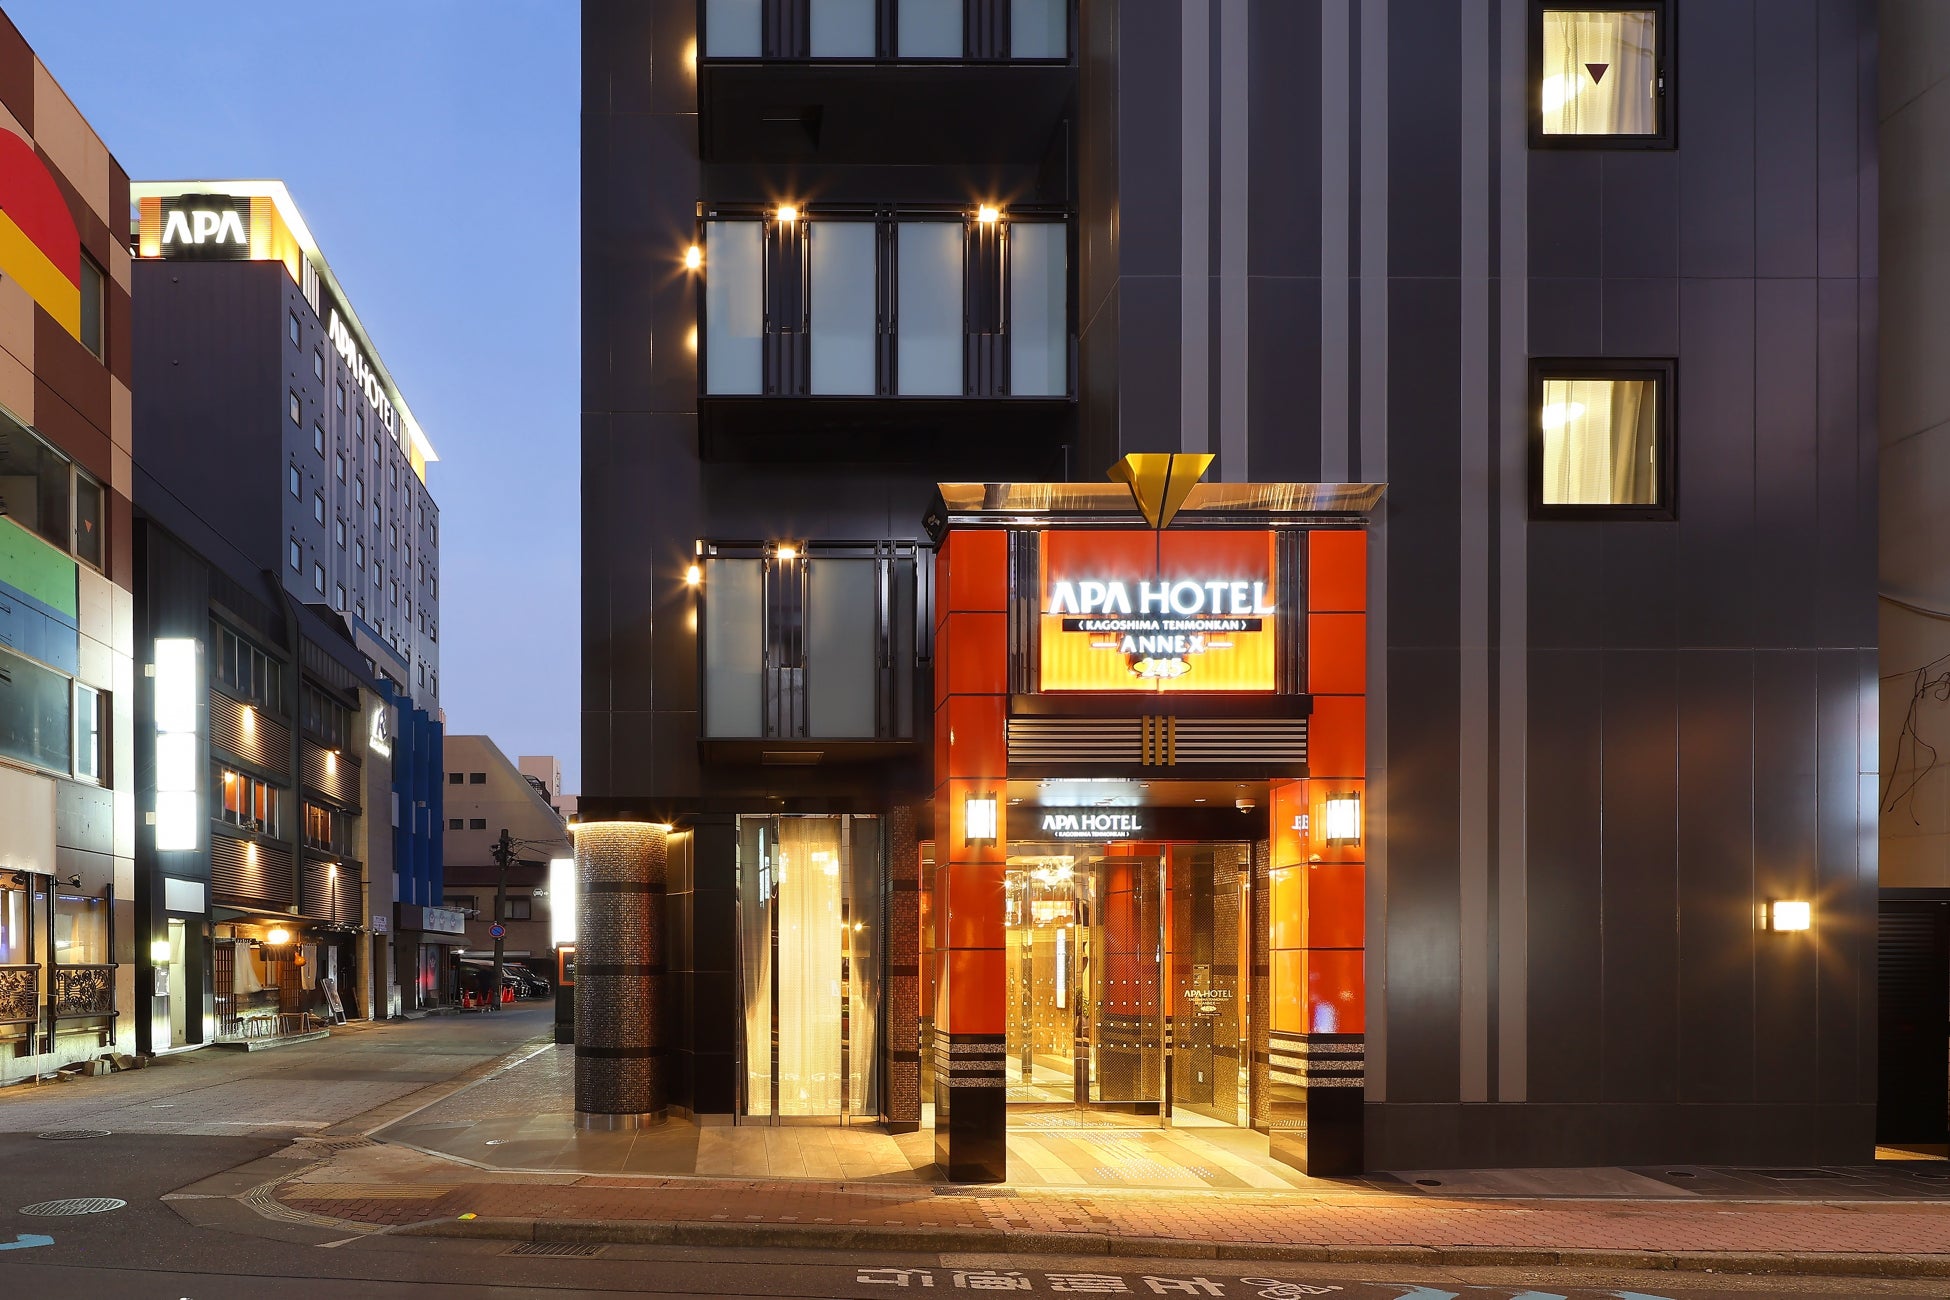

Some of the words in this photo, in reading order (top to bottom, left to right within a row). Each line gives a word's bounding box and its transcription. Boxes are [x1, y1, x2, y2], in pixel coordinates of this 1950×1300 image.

[162, 211, 247, 243] APA
[329, 308, 358, 380] APA
[359, 353, 397, 441] HOTEL
[1049, 581, 1132, 614] APA
[1140, 581, 1275, 615] HOTEL
[1120, 635, 1204, 653] ANNEX
[1142, 657, 1182, 677] 245
[1042, 814, 1080, 830] APA
[1081, 814, 1142, 830] HOTEL
[1184, 990, 1203, 998] APA
[1203, 990, 1233, 998] HOTEL
[857, 1268, 1225, 1297] 左側通行
